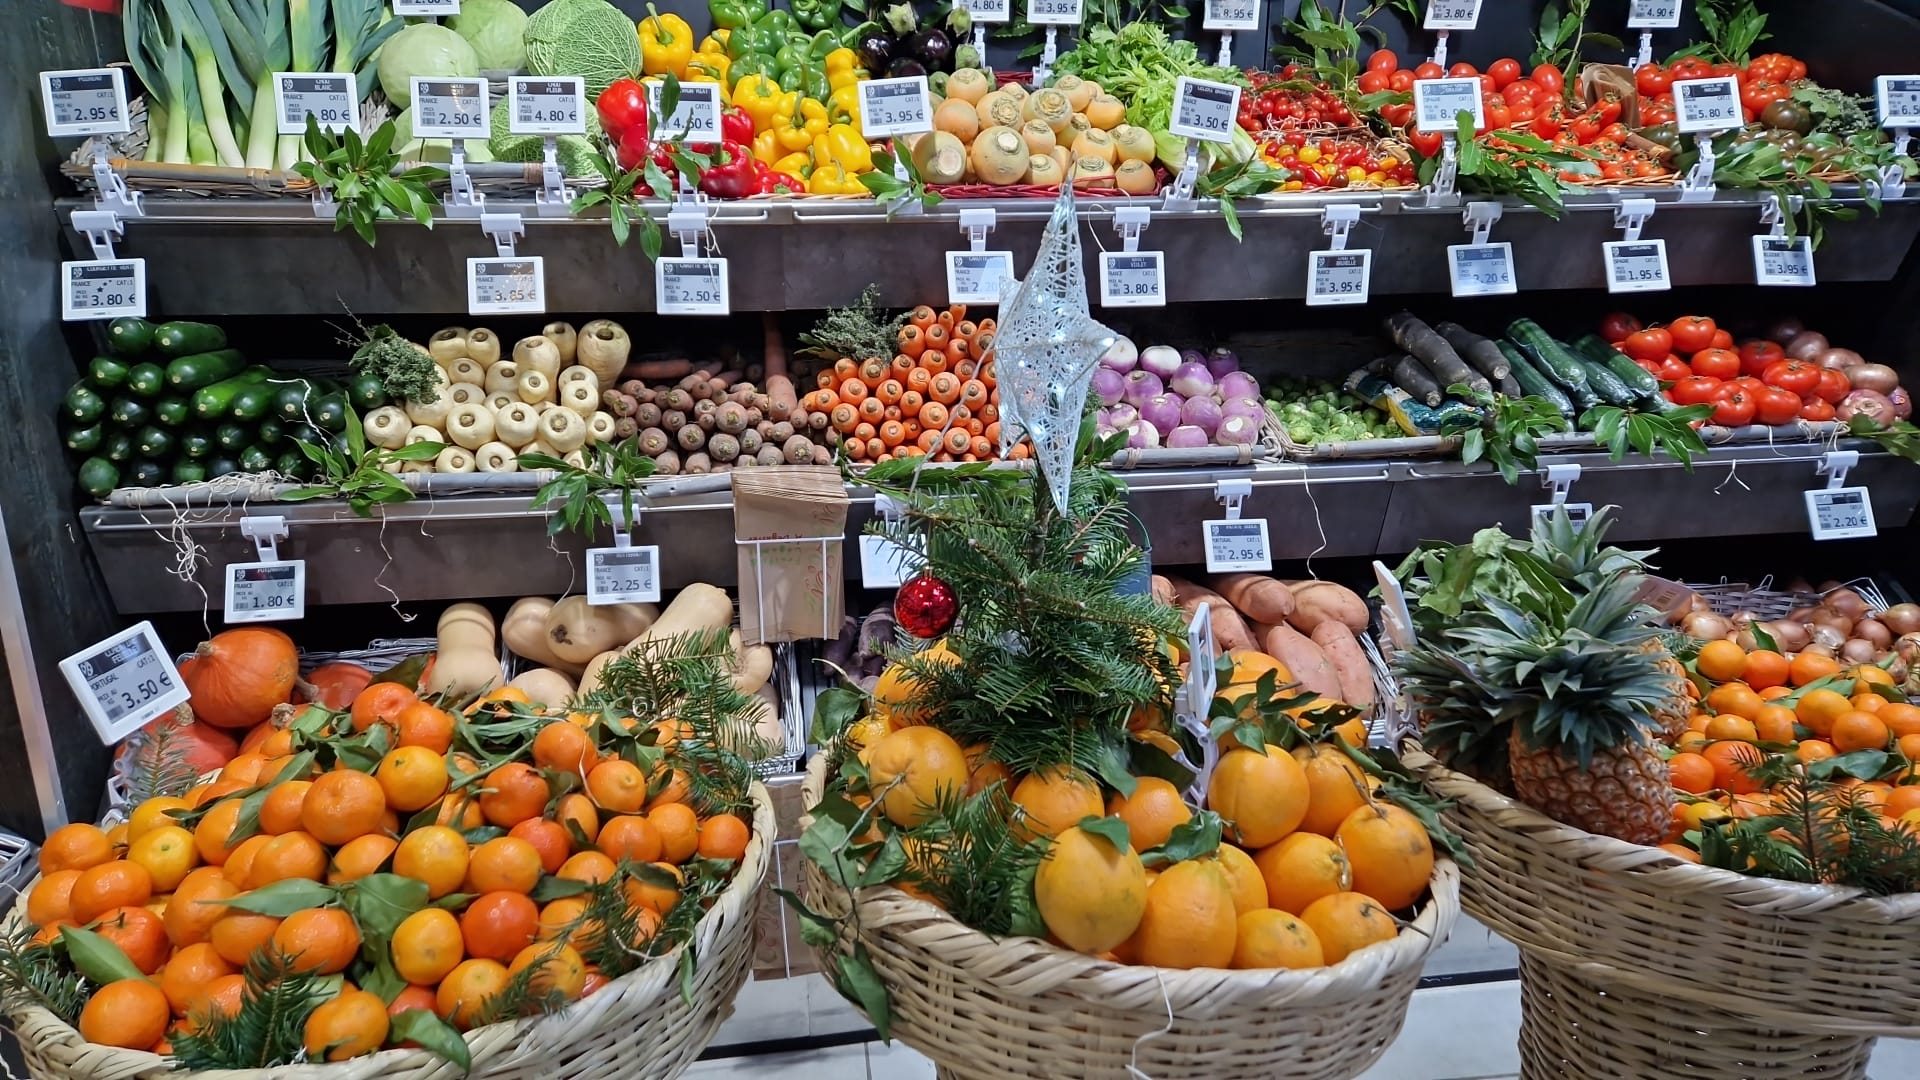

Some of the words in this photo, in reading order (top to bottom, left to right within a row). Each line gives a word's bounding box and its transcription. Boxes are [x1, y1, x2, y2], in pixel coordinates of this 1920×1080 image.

[972, 0, 995, 10] 4.80
[996, 0, 1004, 9] €
[1047, 2, 1069, 13] 3.95
[1070, 2, 1077, 12] €
[1223, 8, 1245, 19] 8.95
[1247, 9, 1254, 18] €
[1444, 8, 1466, 18] 3.80
[1467, 9, 1473, 18] €
[1646, 8, 1667, 17] 4.90
[1668, 8, 1674, 17] €
[75, 107, 107, 121] 2.95
[109, 106, 119, 118] €
[341, 109, 350, 121] €
[535, 110, 565, 121] 4.80
[569, 110, 577, 121] €
[1698, 108, 1721, 119] 5.80
[1727, 106, 1734, 116] €
[1902, 104, 1920, 115] 6.5
[439, 113, 470, 125] 2.50
[473, 113, 482, 125] €
[885, 110, 914, 123] 3.95
[915, 109, 924, 119] €
[1193, 114, 1219, 128] 3.50
[1221, 119, 1229, 129] €
[705, 118, 713, 128] €
[1628, 269, 1652, 280] 1.95
[1654, 269, 1662, 279] €
[1777, 264, 1799, 274] 3.95
[1801, 264, 1808, 274] €
[1501, 272, 1509, 281] €
[1123, 284, 1148, 295] 3.80
[1150, 283, 1158, 293] €
[1328, 281, 1353, 293] 3.95
[1354, 280, 1362, 291] €
[91, 294, 123, 306] 3.80
[128, 293, 136, 304] €
[527, 288, 536, 299] €
[682, 290, 710, 302] 2.50
[712, 291, 721, 301] €
[1833, 516, 1857, 528] 2.20
[1860, 515, 1868, 525] €
[1228, 549, 1254, 560] 2.95
[1256, 549, 1264, 559] €
[611, 580, 641, 592] 2.25
[644, 579, 652, 589] €
[252, 595, 283, 608] 1.80
[286, 594, 295, 604] €
[121, 678, 158, 709] 3.50
[159, 671, 172, 686] €
